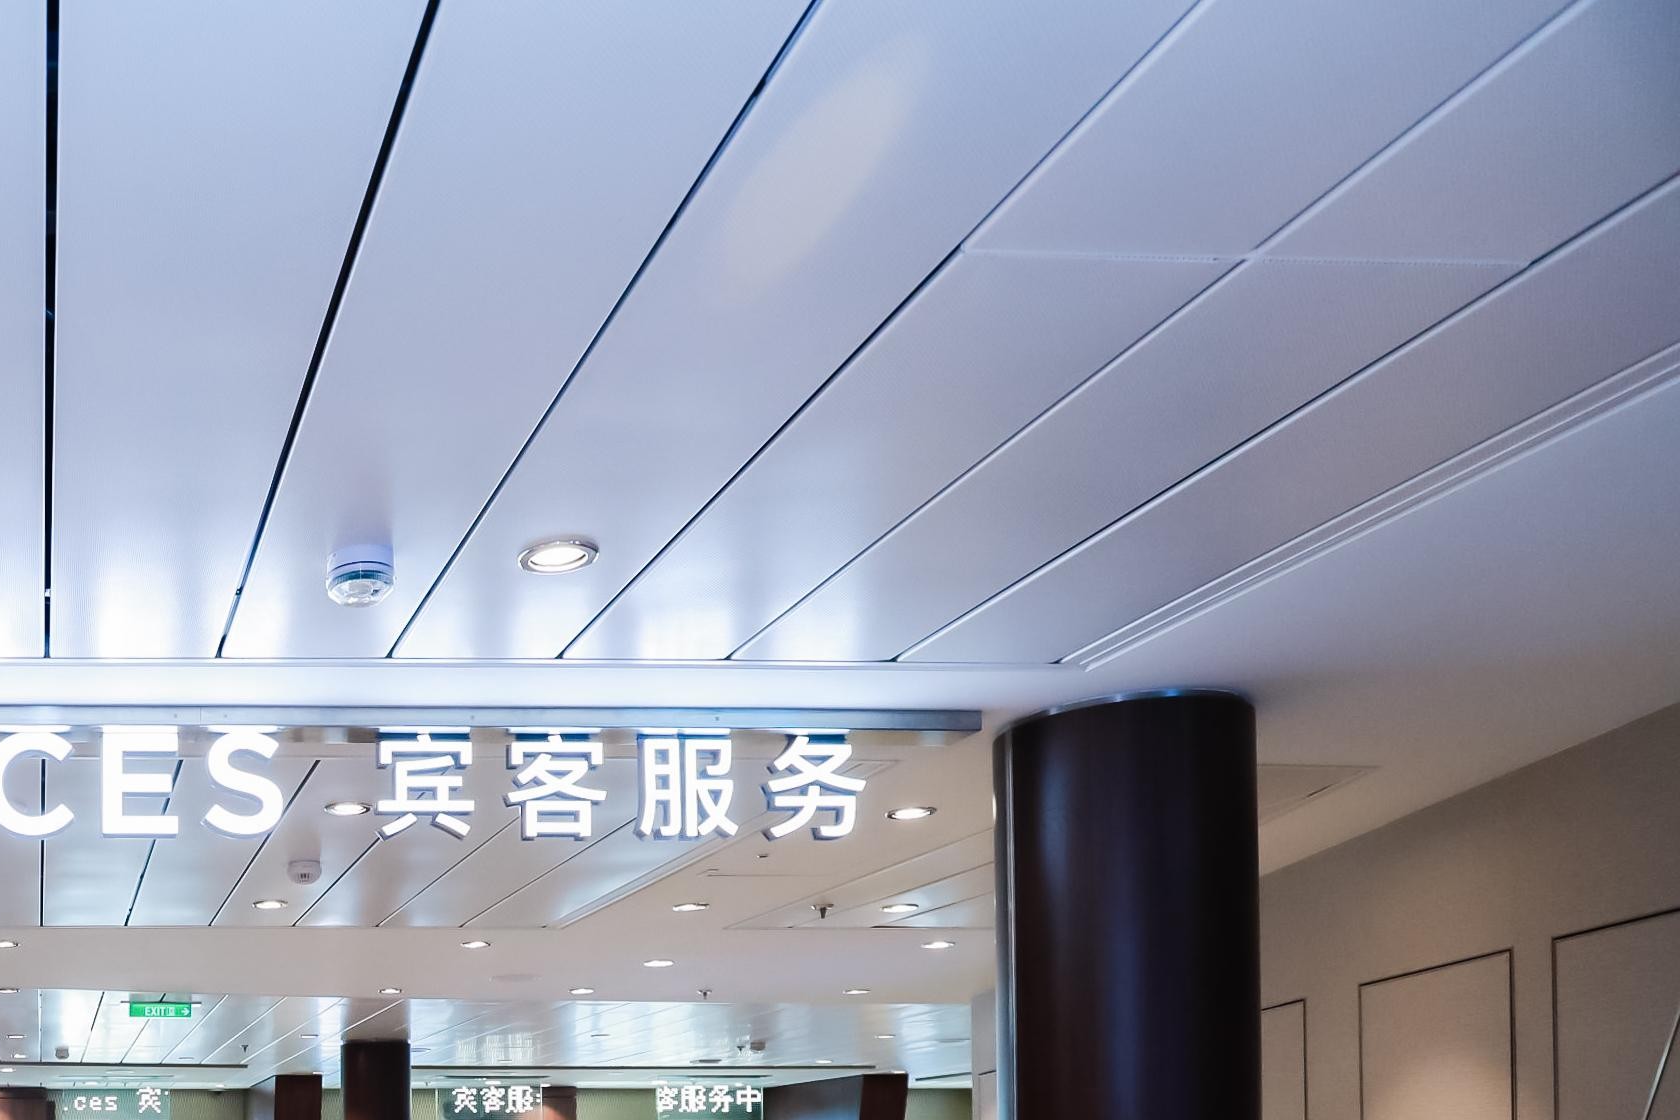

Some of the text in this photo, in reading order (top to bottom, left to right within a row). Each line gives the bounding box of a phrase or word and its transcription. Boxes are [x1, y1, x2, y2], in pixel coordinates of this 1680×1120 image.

[375, 735, 868, 840] 宾客服务
[145, 1006, 166, 1017] EXIT
[63, 1096, 118, 1112] ces
[452, 1085, 540, 1114] 宾客服
